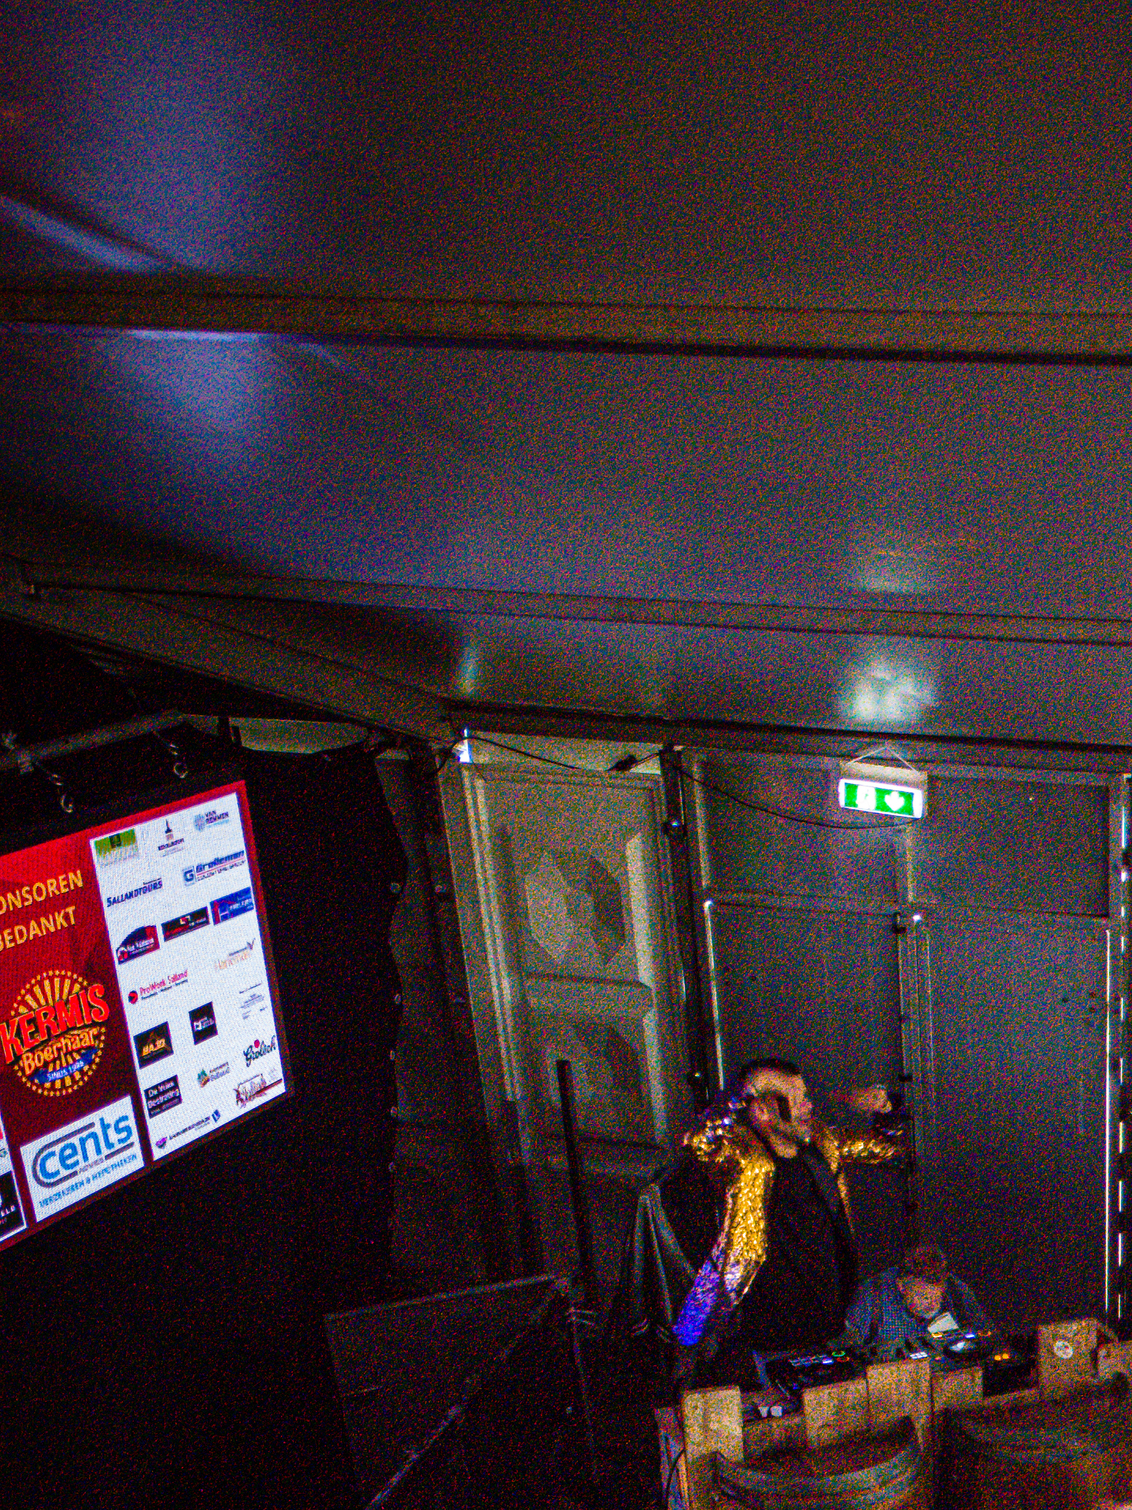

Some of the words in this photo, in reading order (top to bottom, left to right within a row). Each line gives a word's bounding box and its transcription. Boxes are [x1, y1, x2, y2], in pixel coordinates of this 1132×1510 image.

[106, 880, 163, 908] SALLANDTOURS
[0, 984, 110, 1064] KERMIS
[22, 1027, 99, 1075] Boerhaar
[243, 1035, 277, 1067] Grolsch
[39, 1115, 133, 1180] cents
[91, 1153, 138, 1182] HYPOTHEKEN
